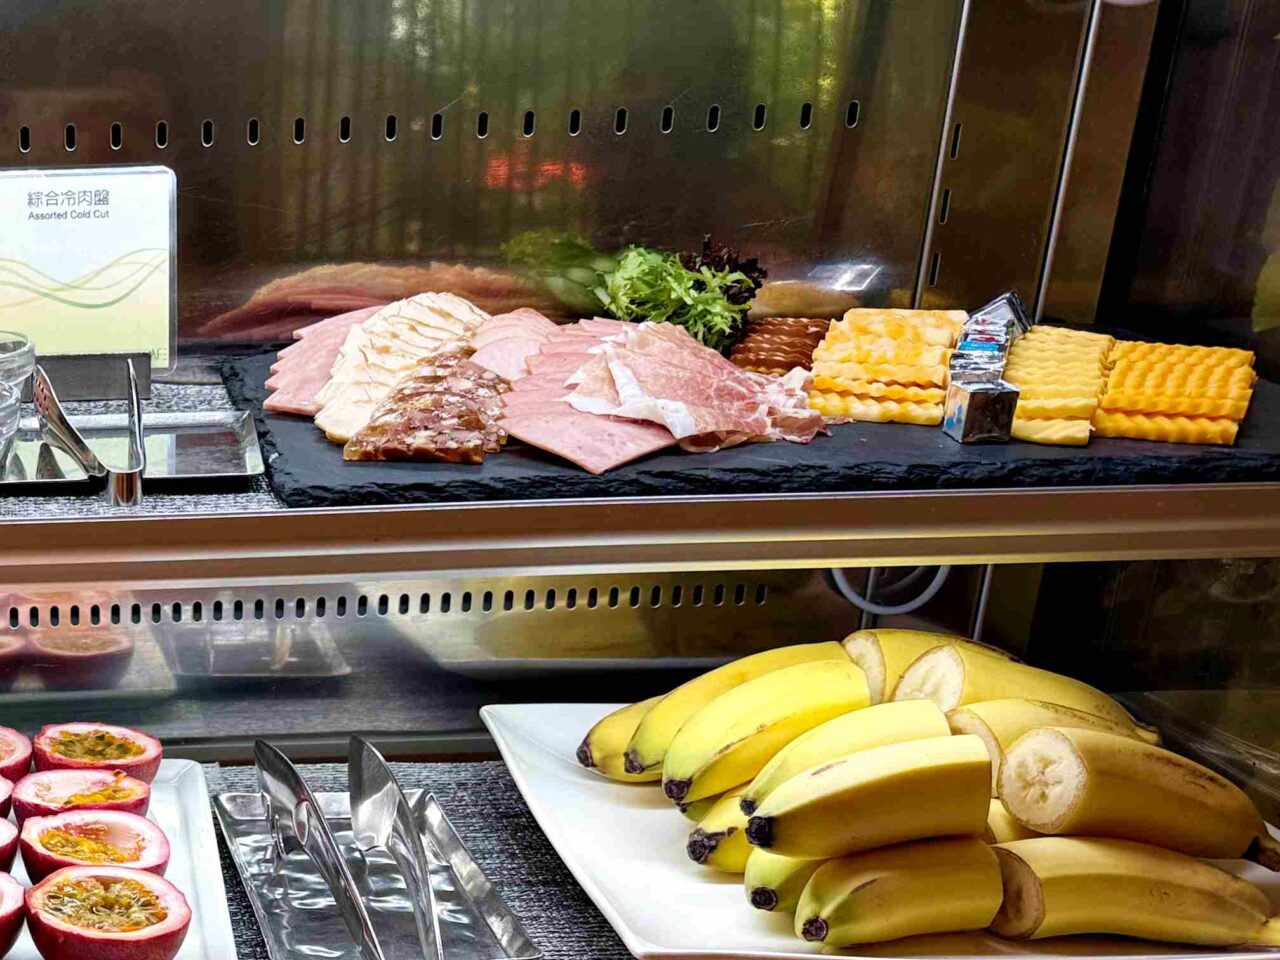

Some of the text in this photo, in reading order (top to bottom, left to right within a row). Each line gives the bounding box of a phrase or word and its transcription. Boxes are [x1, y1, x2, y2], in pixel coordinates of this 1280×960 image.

[27, 189, 109, 208] 綜合冷肉盤
[28, 209, 109, 221] Assorted Cold Cut
